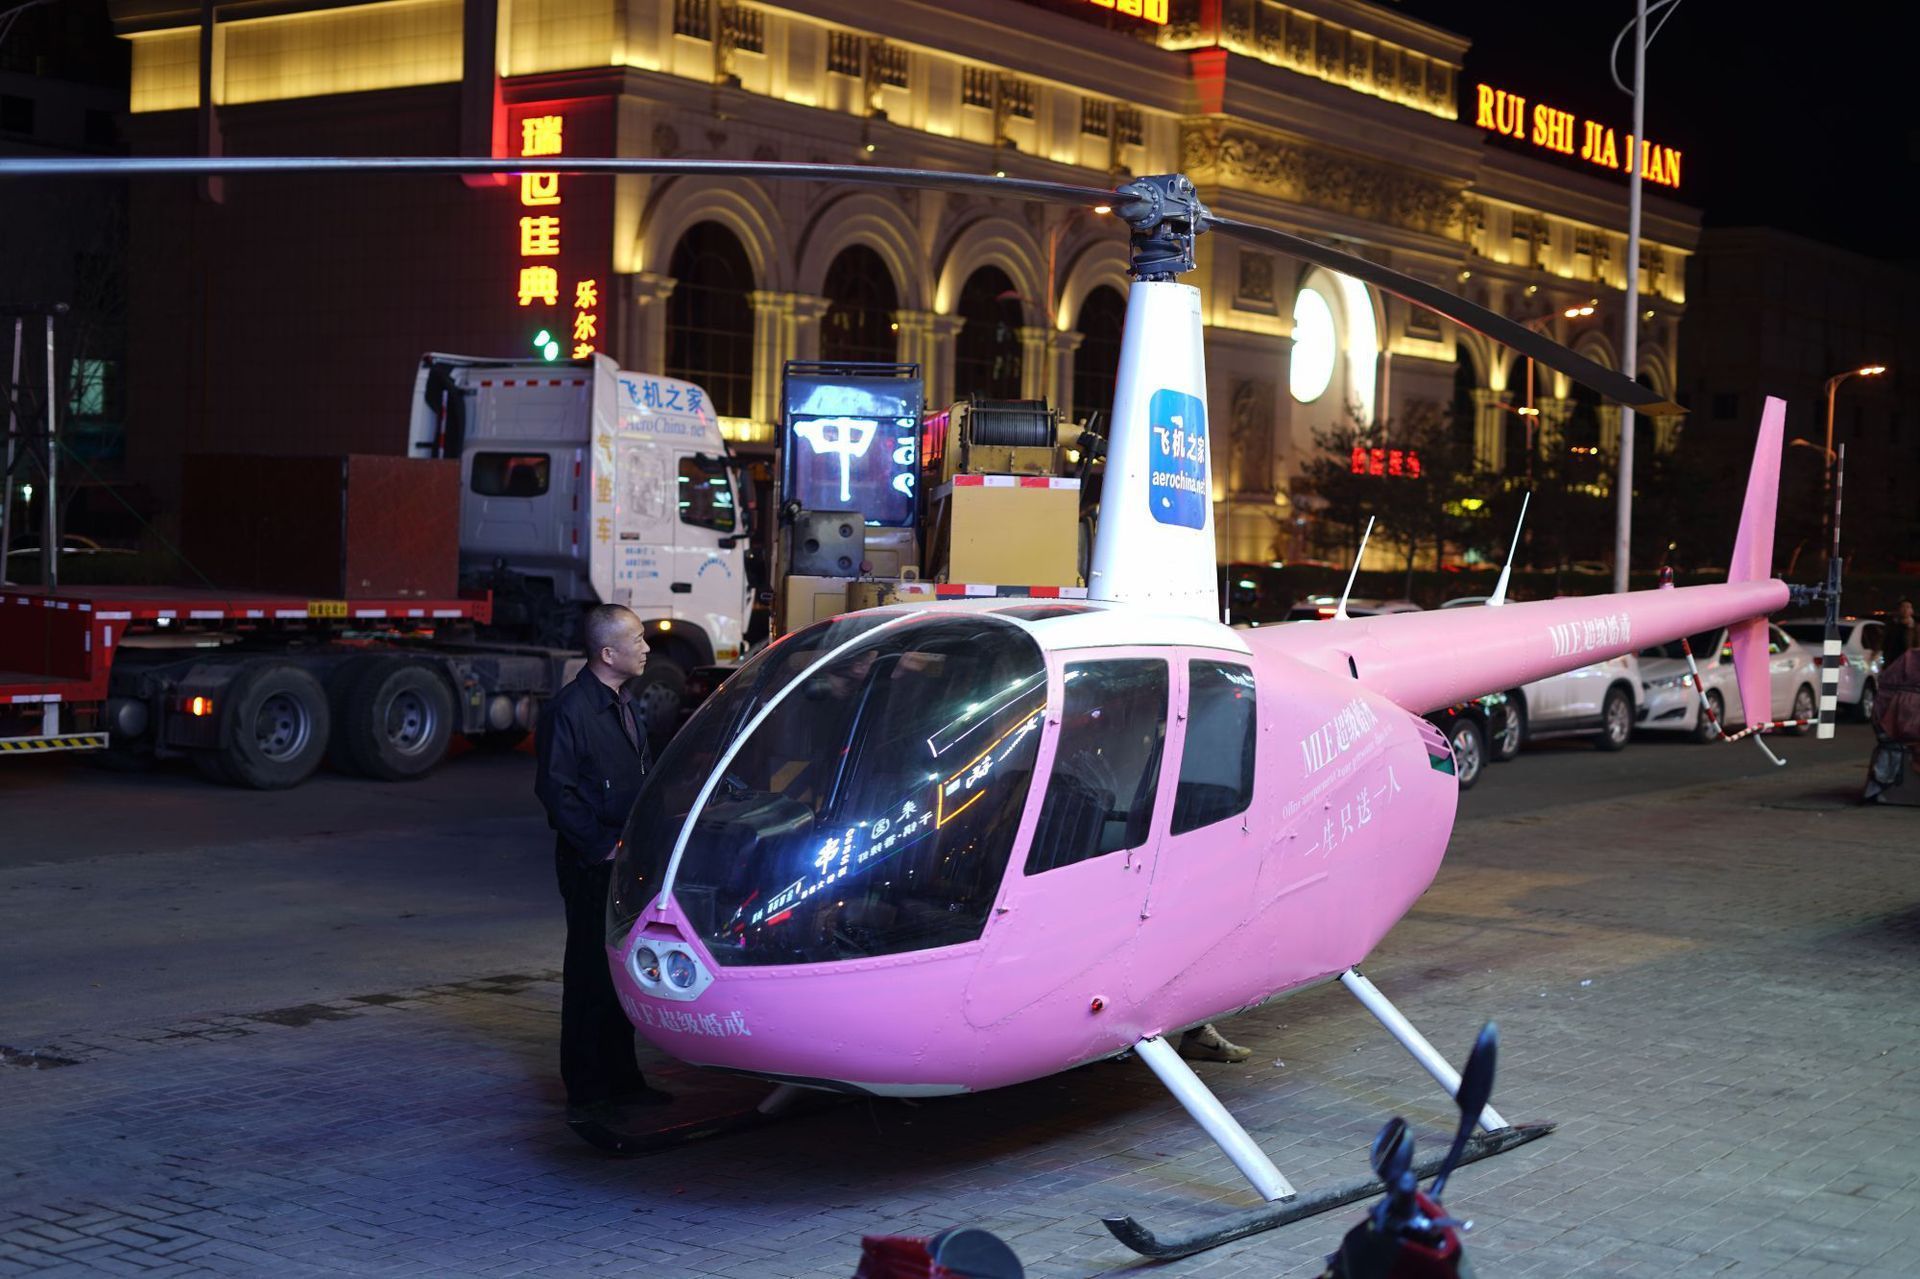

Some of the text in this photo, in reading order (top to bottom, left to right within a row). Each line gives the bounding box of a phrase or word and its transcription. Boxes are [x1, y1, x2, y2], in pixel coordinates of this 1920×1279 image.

[1476, 83, 1526, 139] RUI
[1532, 103, 1575, 155] SHI
[1581, 120, 1619, 169] JIA
[518, 115, 563, 306] 瑞世佳典
[619, 380, 704, 414] 飞机之家
[1153, 426, 1205, 464] 飞机之家
[1304, 765, 1402, 858] 一生只送一人
